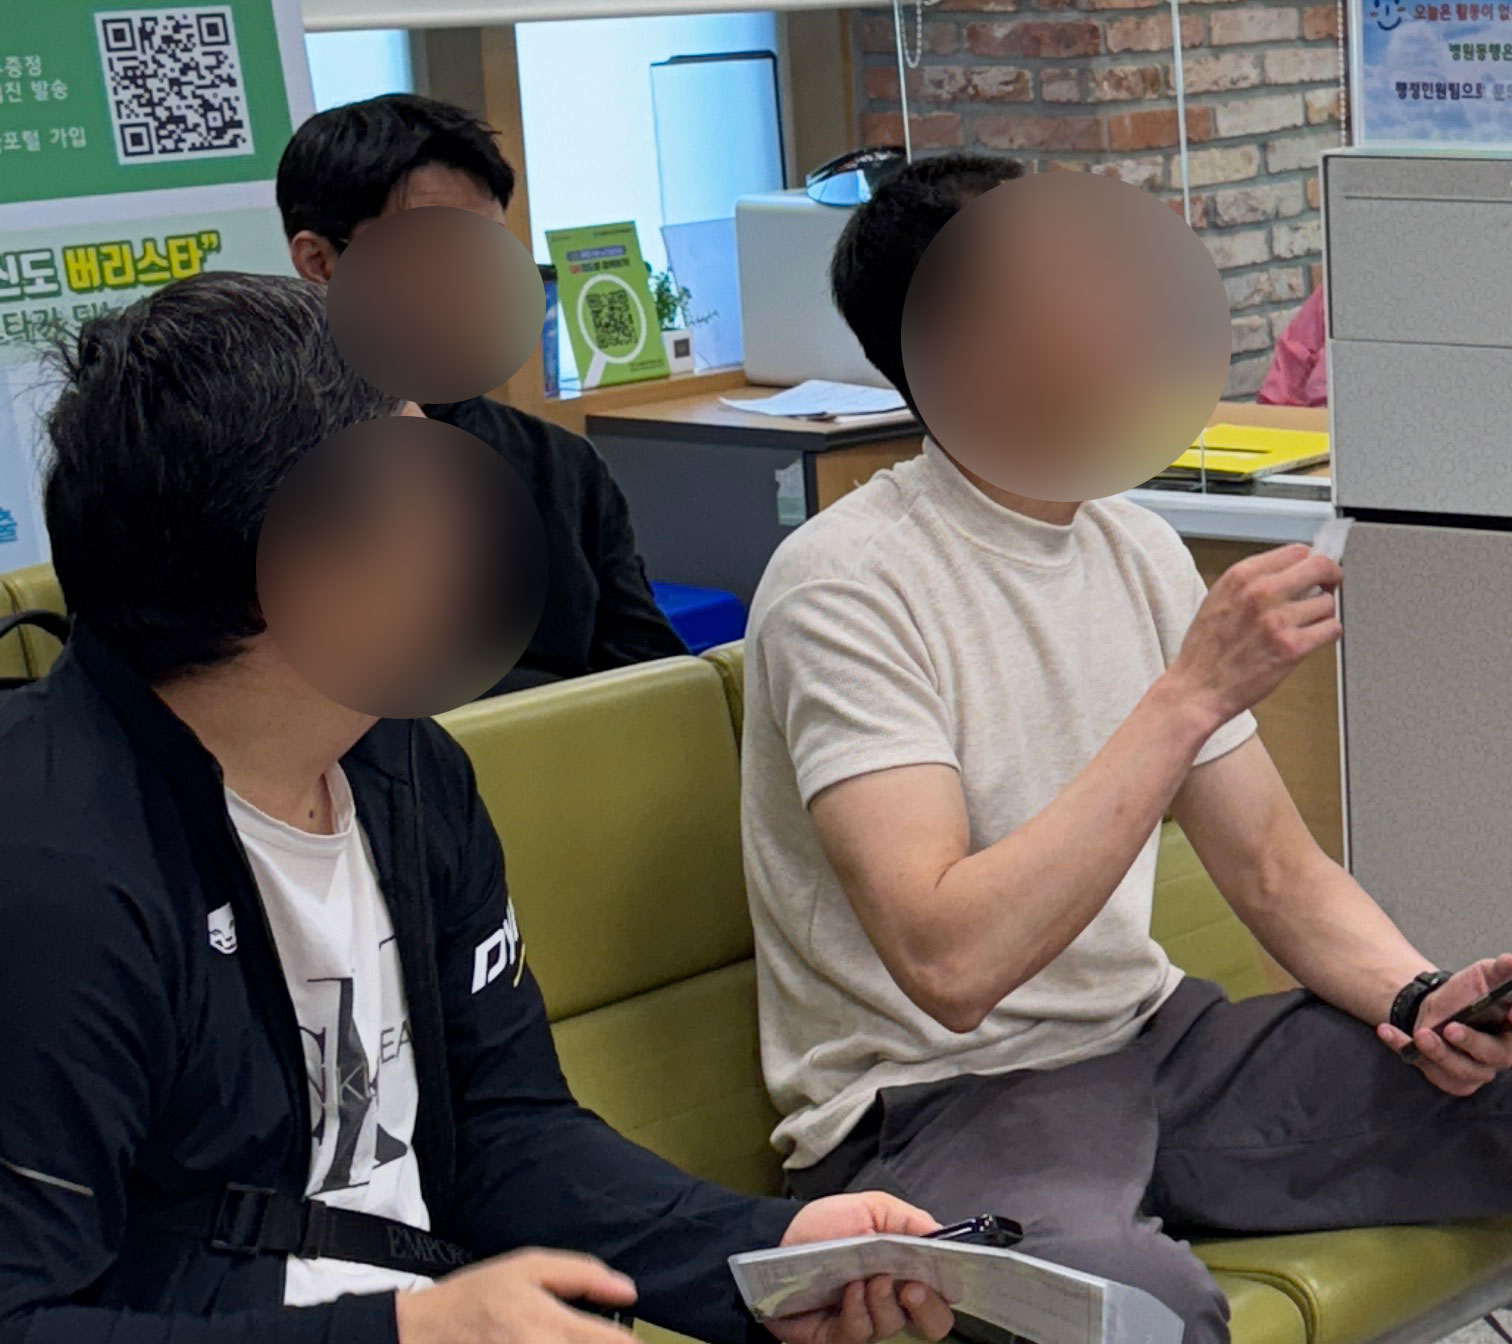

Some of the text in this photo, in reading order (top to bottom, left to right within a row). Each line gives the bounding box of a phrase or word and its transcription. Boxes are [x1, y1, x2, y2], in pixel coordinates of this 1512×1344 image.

[1413, 3, 1452, 22] 오늘은
[0, 54, 42, 78] 증정
[0, 125, 87, 154] 포털 가입
